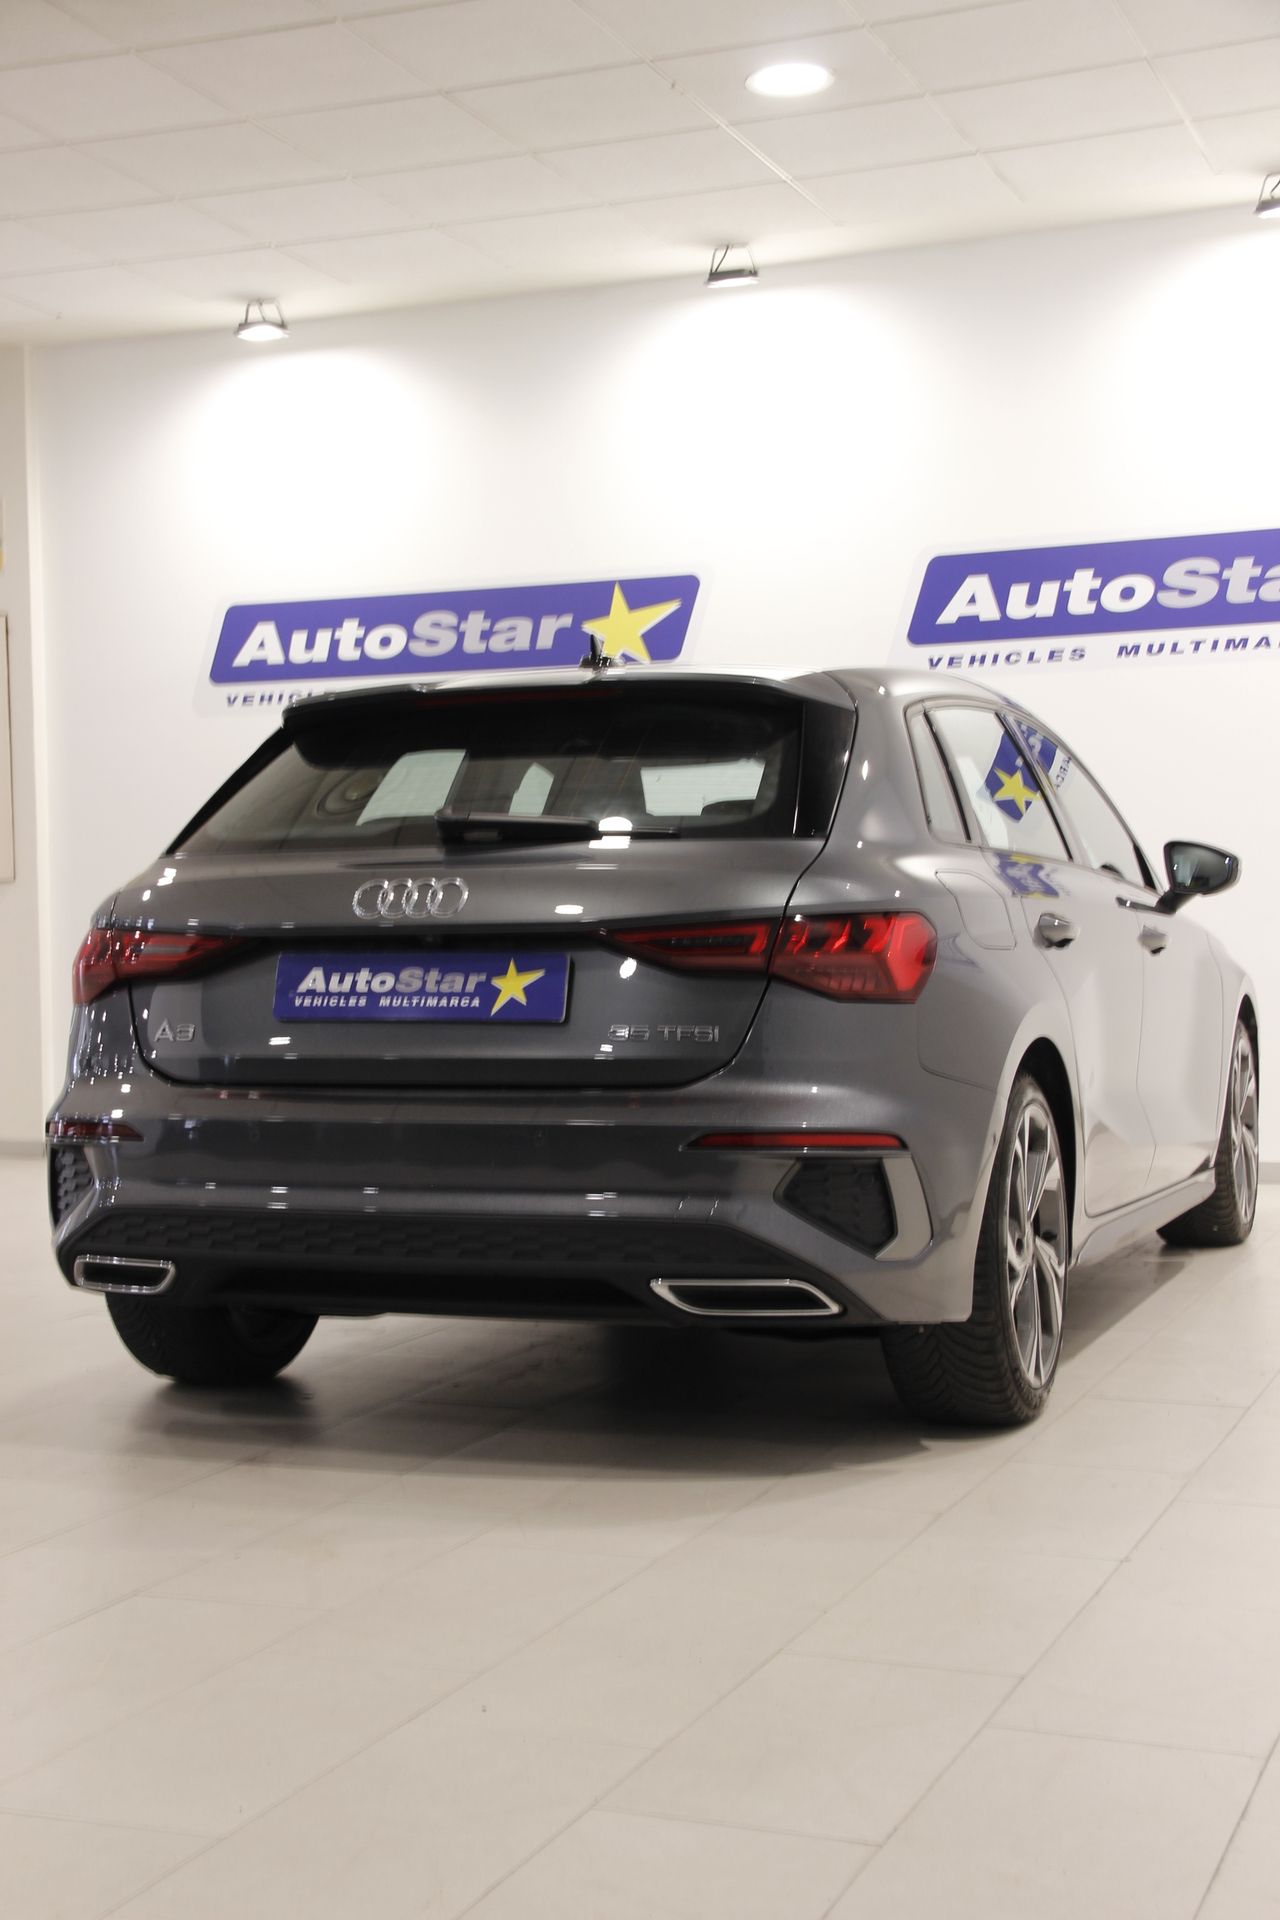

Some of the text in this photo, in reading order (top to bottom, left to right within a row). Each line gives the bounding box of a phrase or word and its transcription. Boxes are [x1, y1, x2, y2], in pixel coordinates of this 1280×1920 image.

[231, 609, 574, 668] AutoStar
[928, 634, 1280, 670] VEHICLES MULTIMA
[296, 966, 487, 994] AutoStar
[294, 995, 480, 1009] VEHICLES MULTIMARCA
[153, 1018, 196, 1042] A3
[608, 1024, 720, 1042] 35 TFSI
